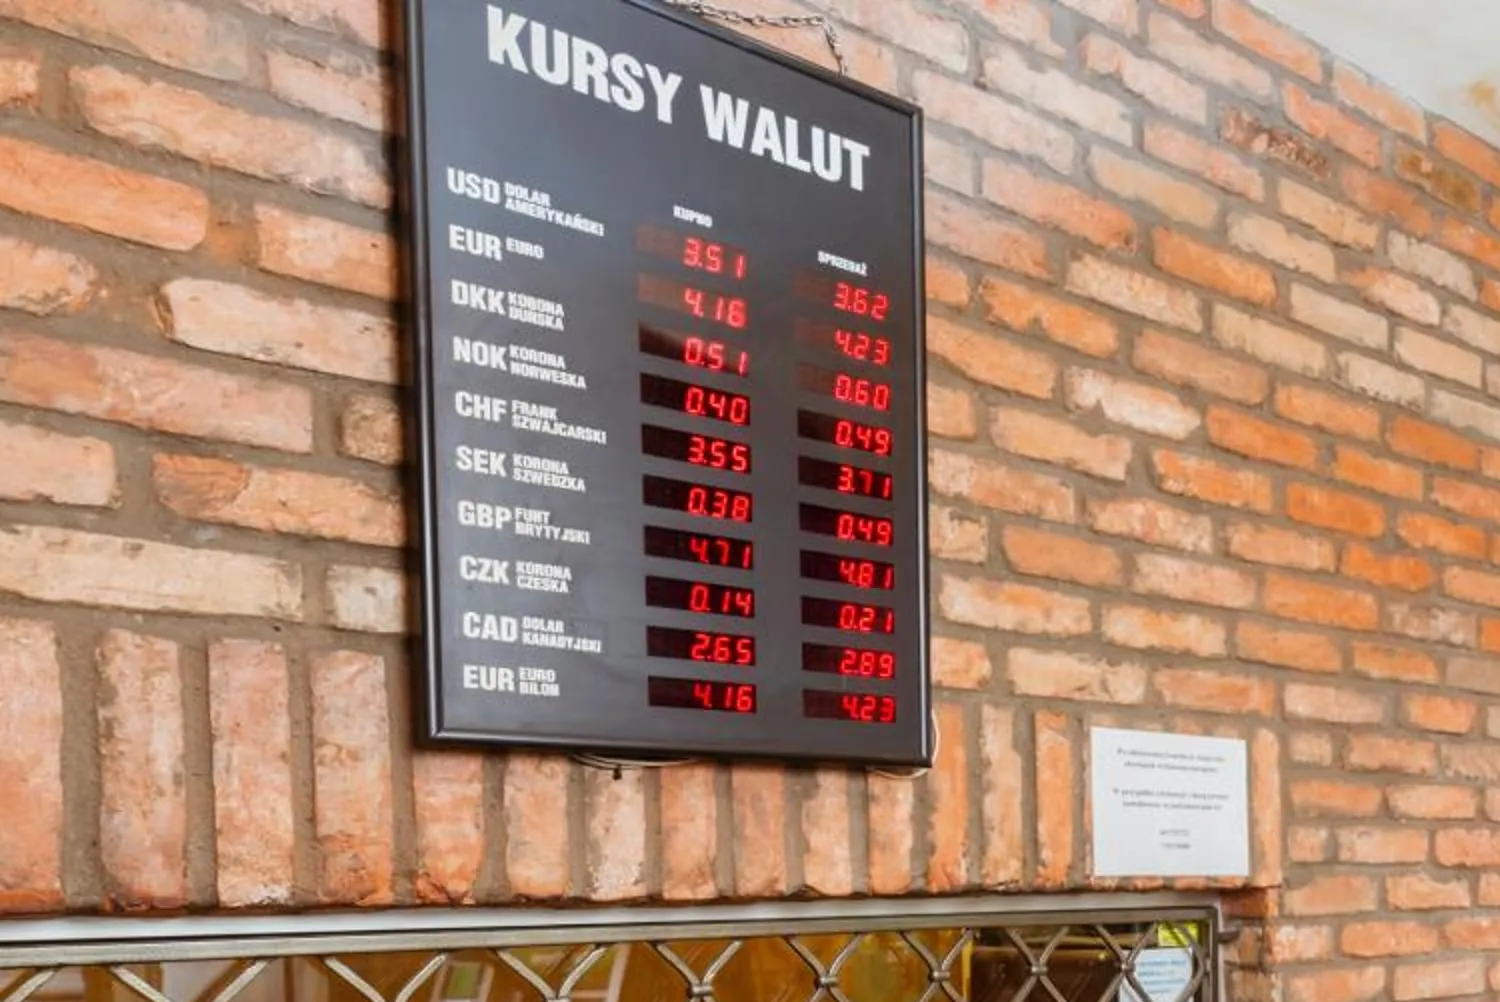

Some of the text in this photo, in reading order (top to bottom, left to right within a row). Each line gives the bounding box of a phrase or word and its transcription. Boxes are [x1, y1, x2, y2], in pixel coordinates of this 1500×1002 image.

[486, 5, 870, 193] KURSY WALUT
[447, 166, 551, 206] USD DOLAR
[449, 223, 544, 261] EUR EURO
[684, 238, 746, 279] 3.51
[451, 279, 564, 317] DKK KORONA
[684, 288, 746, 328] 4.16
[833, 282, 888, 320] 3.62
[453, 336, 566, 371] NOK KORONA
[685, 337, 747, 375] 0.51
[834, 329, 889, 365] 4.23
[510, 360, 587, 389] NORWESKA
[455, 391, 557, 422] CHF FRANK
[686, 387, 747, 425] 0.40
[834, 374, 889, 410] 0.60
[512, 414, 607, 444] SZWAJCARSKI
[835, 421, 890, 455] 0.49
[456, 445, 569, 477] SEK KORONA
[688, 437, 747, 472] 3.55
[512, 467, 586, 492] SZWEDZKA
[838, 466, 891, 498] 3.71
[458, 500, 550, 530] GBP FUNT
[688, 488, 749, 521] 0.38
[515, 522, 591, 545] BRYTYJSKI
[837, 514, 891, 546] 0.49
[690, 536, 751, 568] 4.71
[460, 555, 572, 584] CZK KORONA
[517, 575, 569, 593] CZESKA
[840, 560, 892, 588] 4.81
[690, 583, 752, 615] 0.14
[463, 611, 565, 643] CAD DOLAR
[840, 605, 892, 633] 0.21
[522, 631, 602, 653] KANADYJSKI
[691, 633, 751, 664] 2.65
[463, 664, 556, 692] EUR EURO
[840, 650, 893, 678] 2.89
[693, 684, 752, 711] 4.16
[842, 696, 895, 722] 4.23
